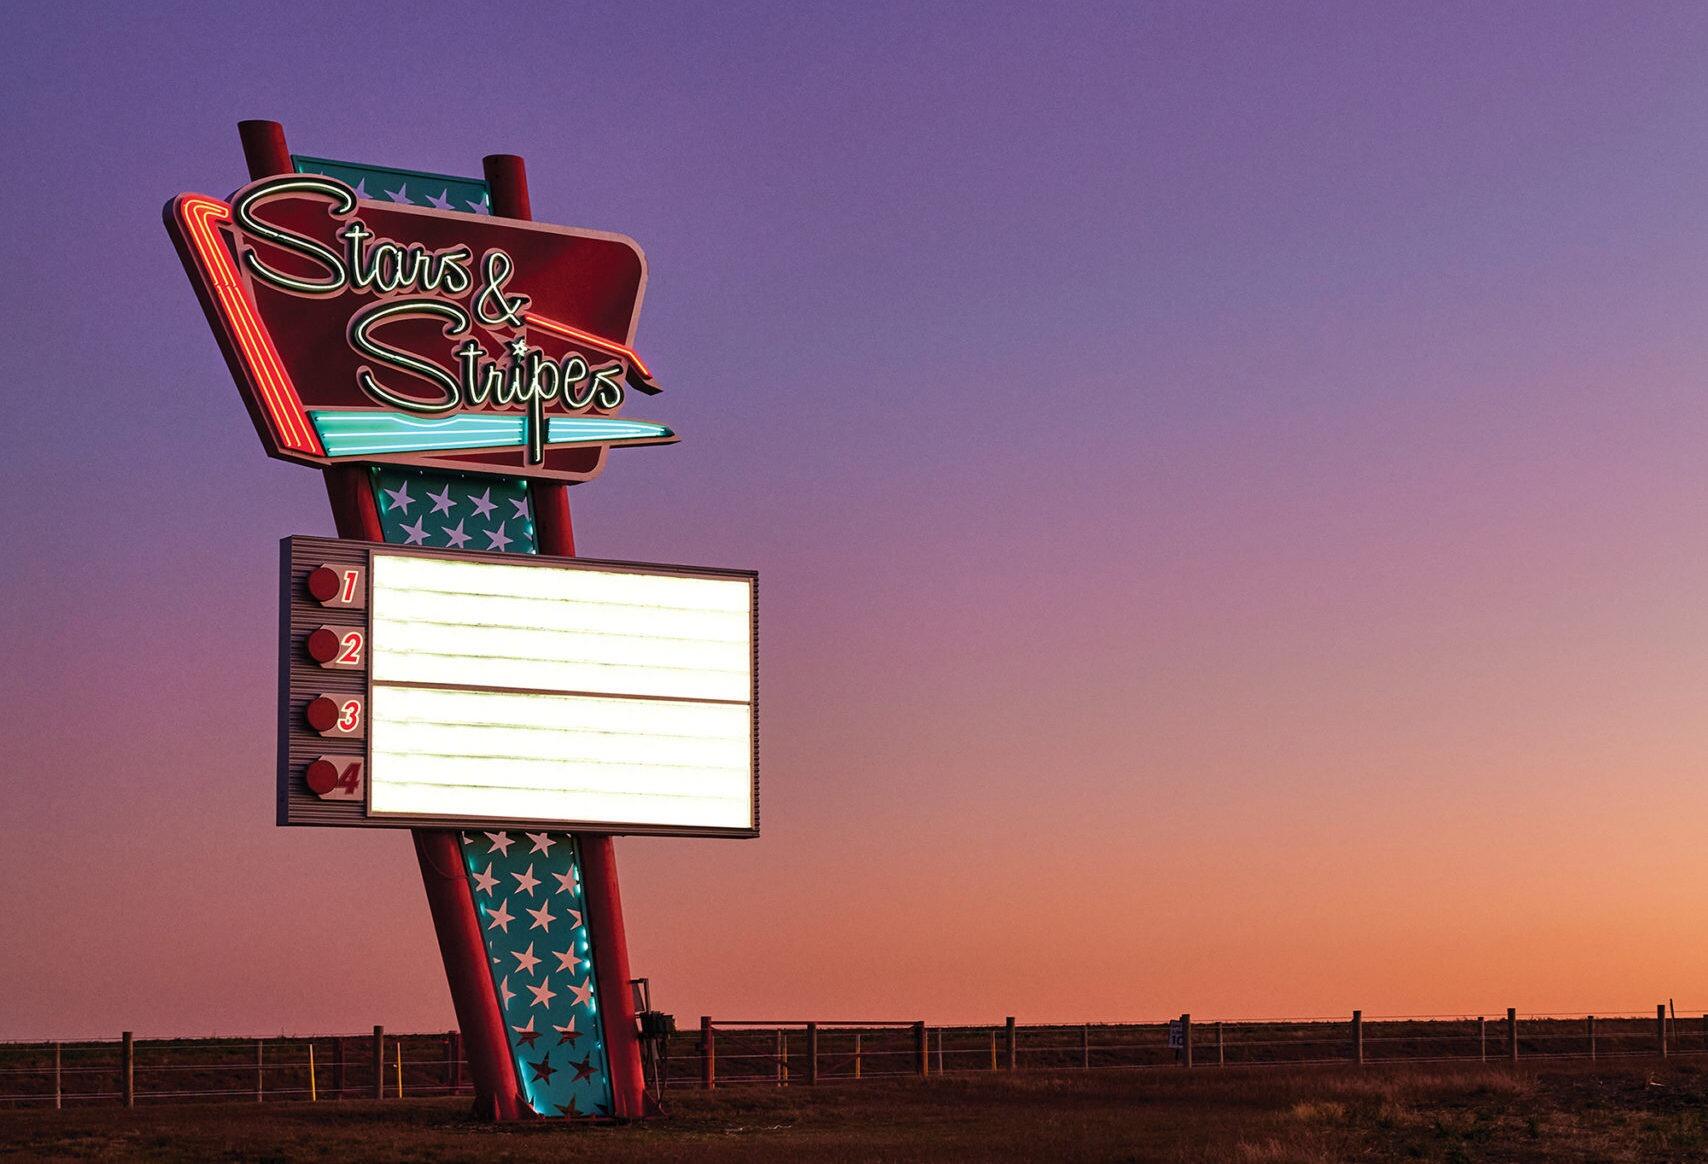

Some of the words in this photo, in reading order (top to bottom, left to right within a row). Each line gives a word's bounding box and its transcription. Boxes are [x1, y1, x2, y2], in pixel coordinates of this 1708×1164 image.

[236, 177, 472, 294] Stars
[477, 250, 529, 328] &
[349, 300, 624, 464] Stripes
[340, 570, 359, 603] 1
[337, 631, 363, 665] 2
[337, 701, 361, 732] 3
[337, 762, 362, 795] 4
